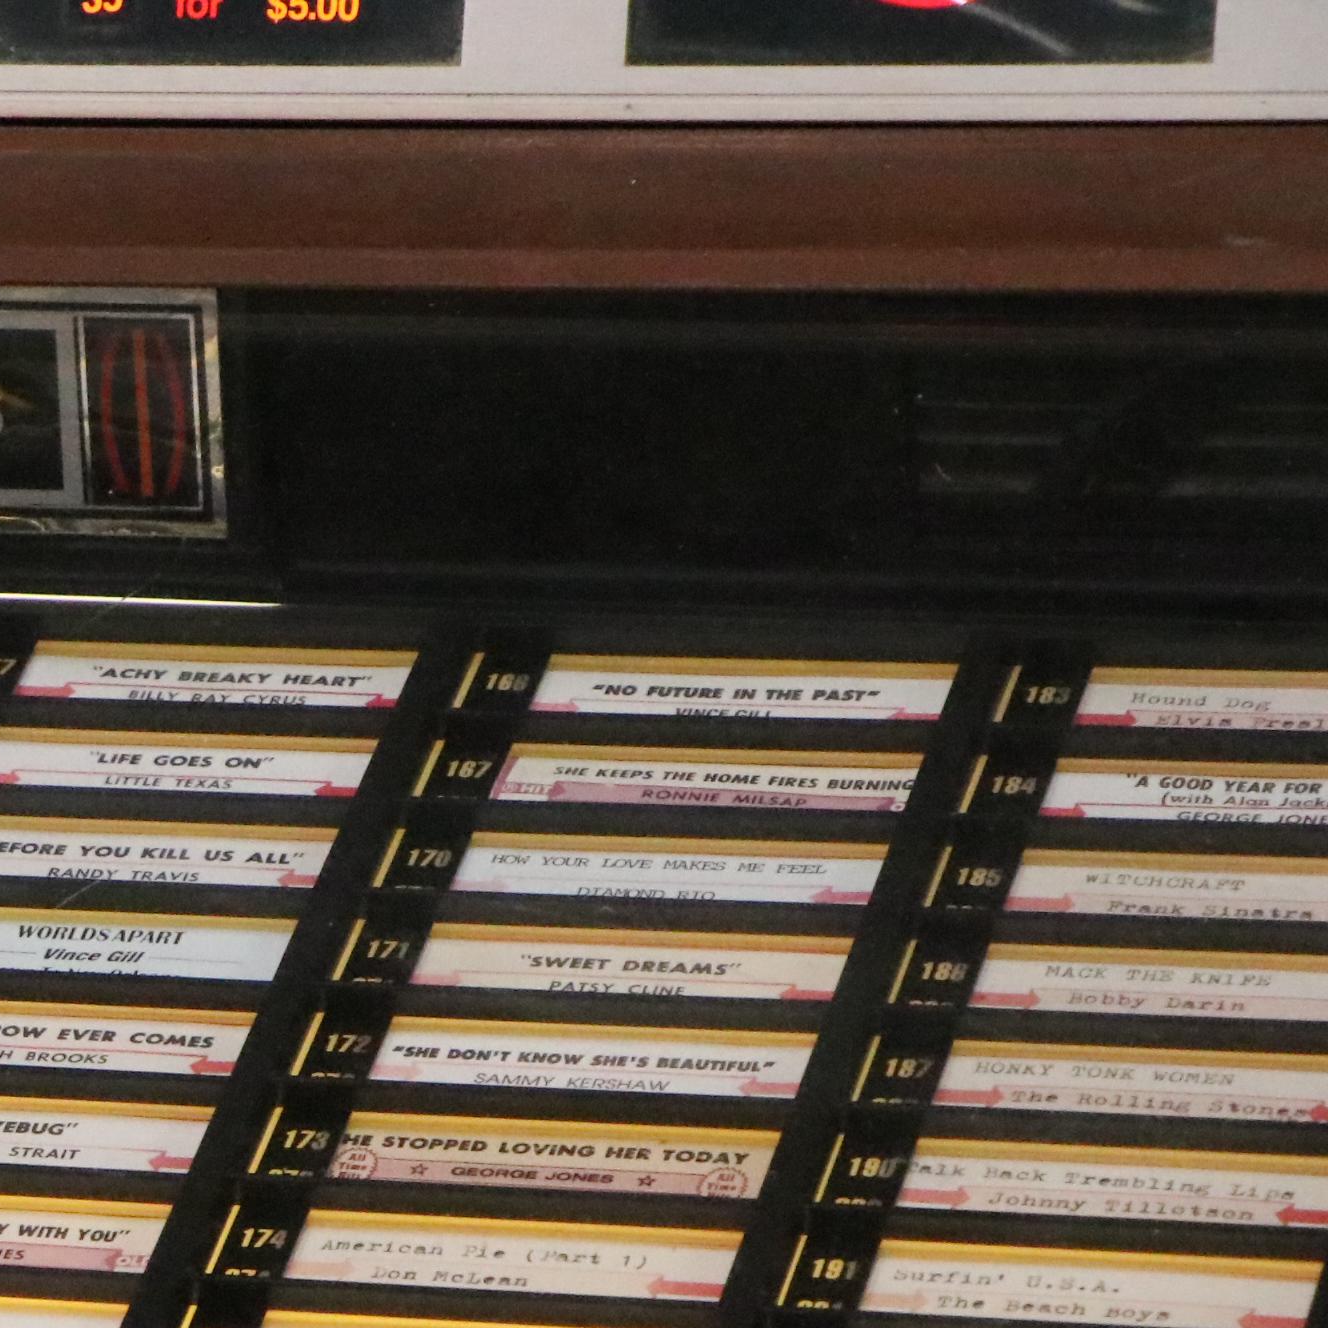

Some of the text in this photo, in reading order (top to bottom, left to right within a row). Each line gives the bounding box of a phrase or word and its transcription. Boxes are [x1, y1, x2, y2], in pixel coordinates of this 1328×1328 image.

[94, 666, 372, 689] "ACHY BREAKY HEART"
[522, 954, 743, 976] "SWEET DREAMS"
[10, 1146, 80, 1161] STRAIT
